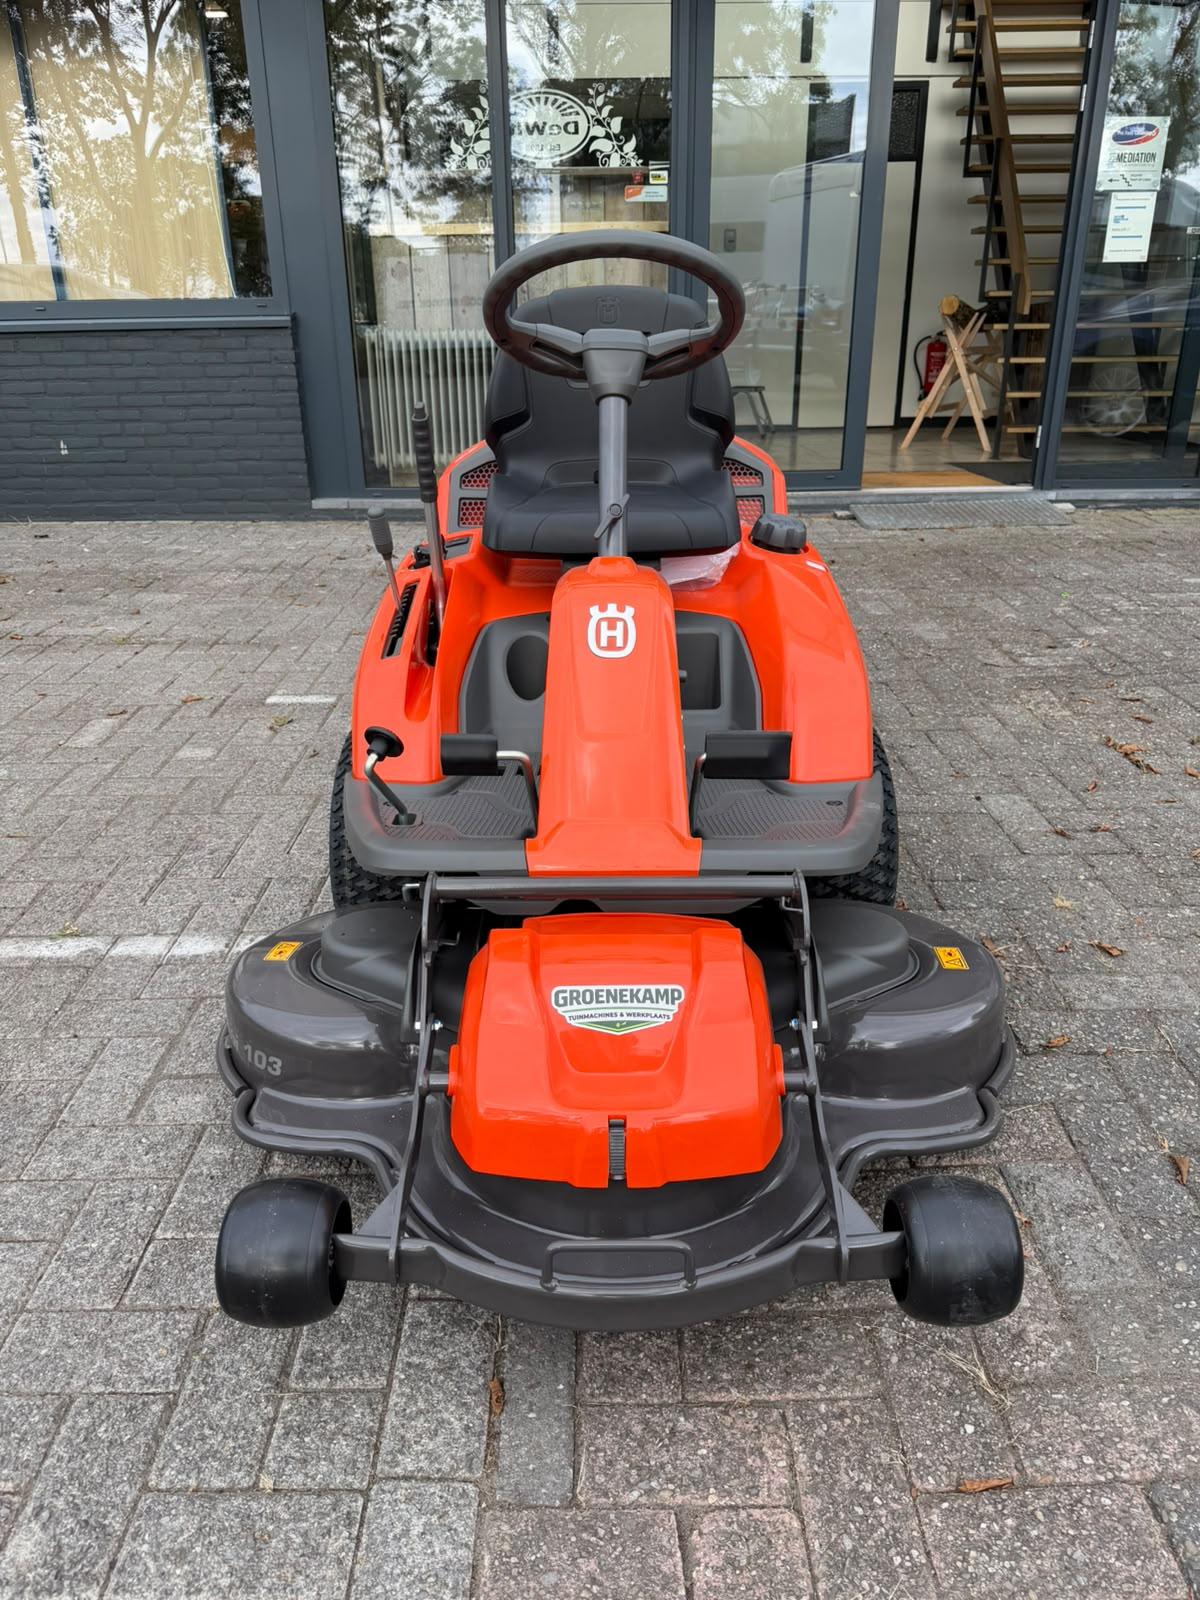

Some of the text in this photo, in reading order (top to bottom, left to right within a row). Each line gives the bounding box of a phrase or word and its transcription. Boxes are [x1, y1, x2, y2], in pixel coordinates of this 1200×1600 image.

[1116, 152, 1157, 163] MEDIATION
[553, 987, 682, 1008] GROENEKAMP
[568, 1011, 618, 1021] TUINMACHINES
[625, 1011, 671, 1020] WERKPLAATS
[244, 1044, 282, 1076] 103
